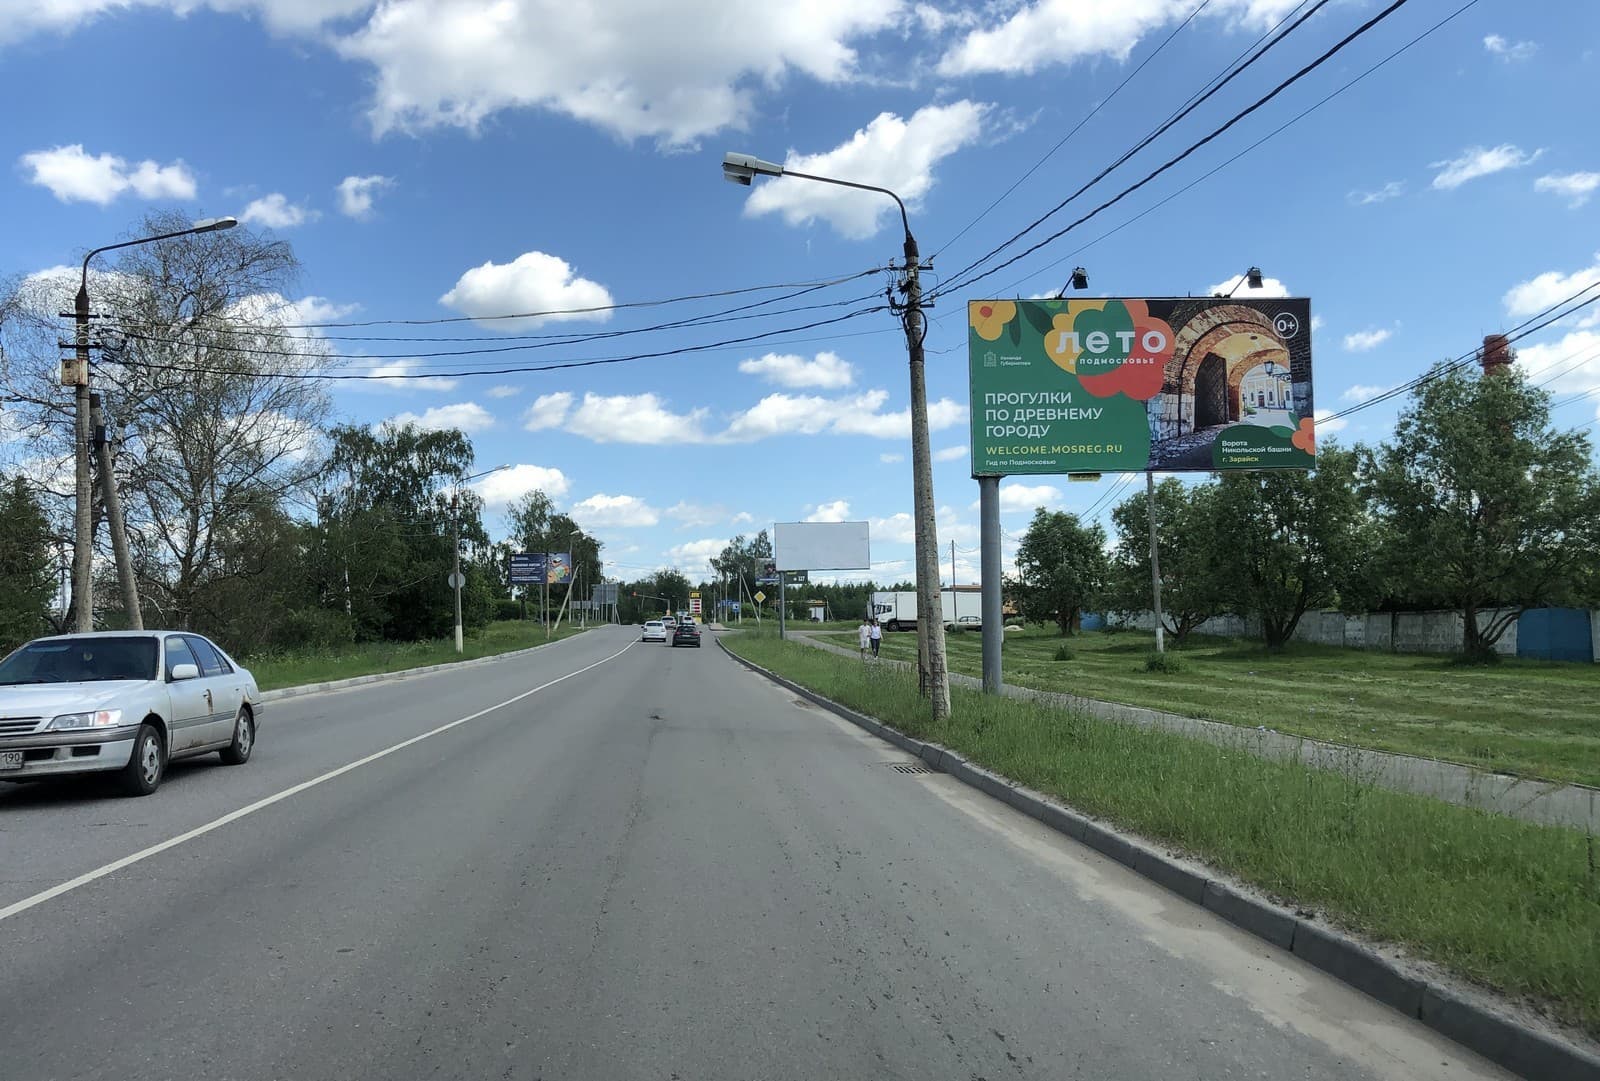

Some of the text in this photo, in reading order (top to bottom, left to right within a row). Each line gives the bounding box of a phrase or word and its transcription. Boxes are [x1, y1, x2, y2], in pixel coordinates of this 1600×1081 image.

[1277, 320, 1295, 332] 0+
[985, 392, 1072, 405] ПРОГУЛКИ
[985, 408, 1103, 422] ПО ДРЕВНЕМУ
[986, 425, 1050, 438] ГОРОДУ
[986, 444, 1123, 455] WELCOME.MOSREG.RU
[2, 752, 20, 762] 190
